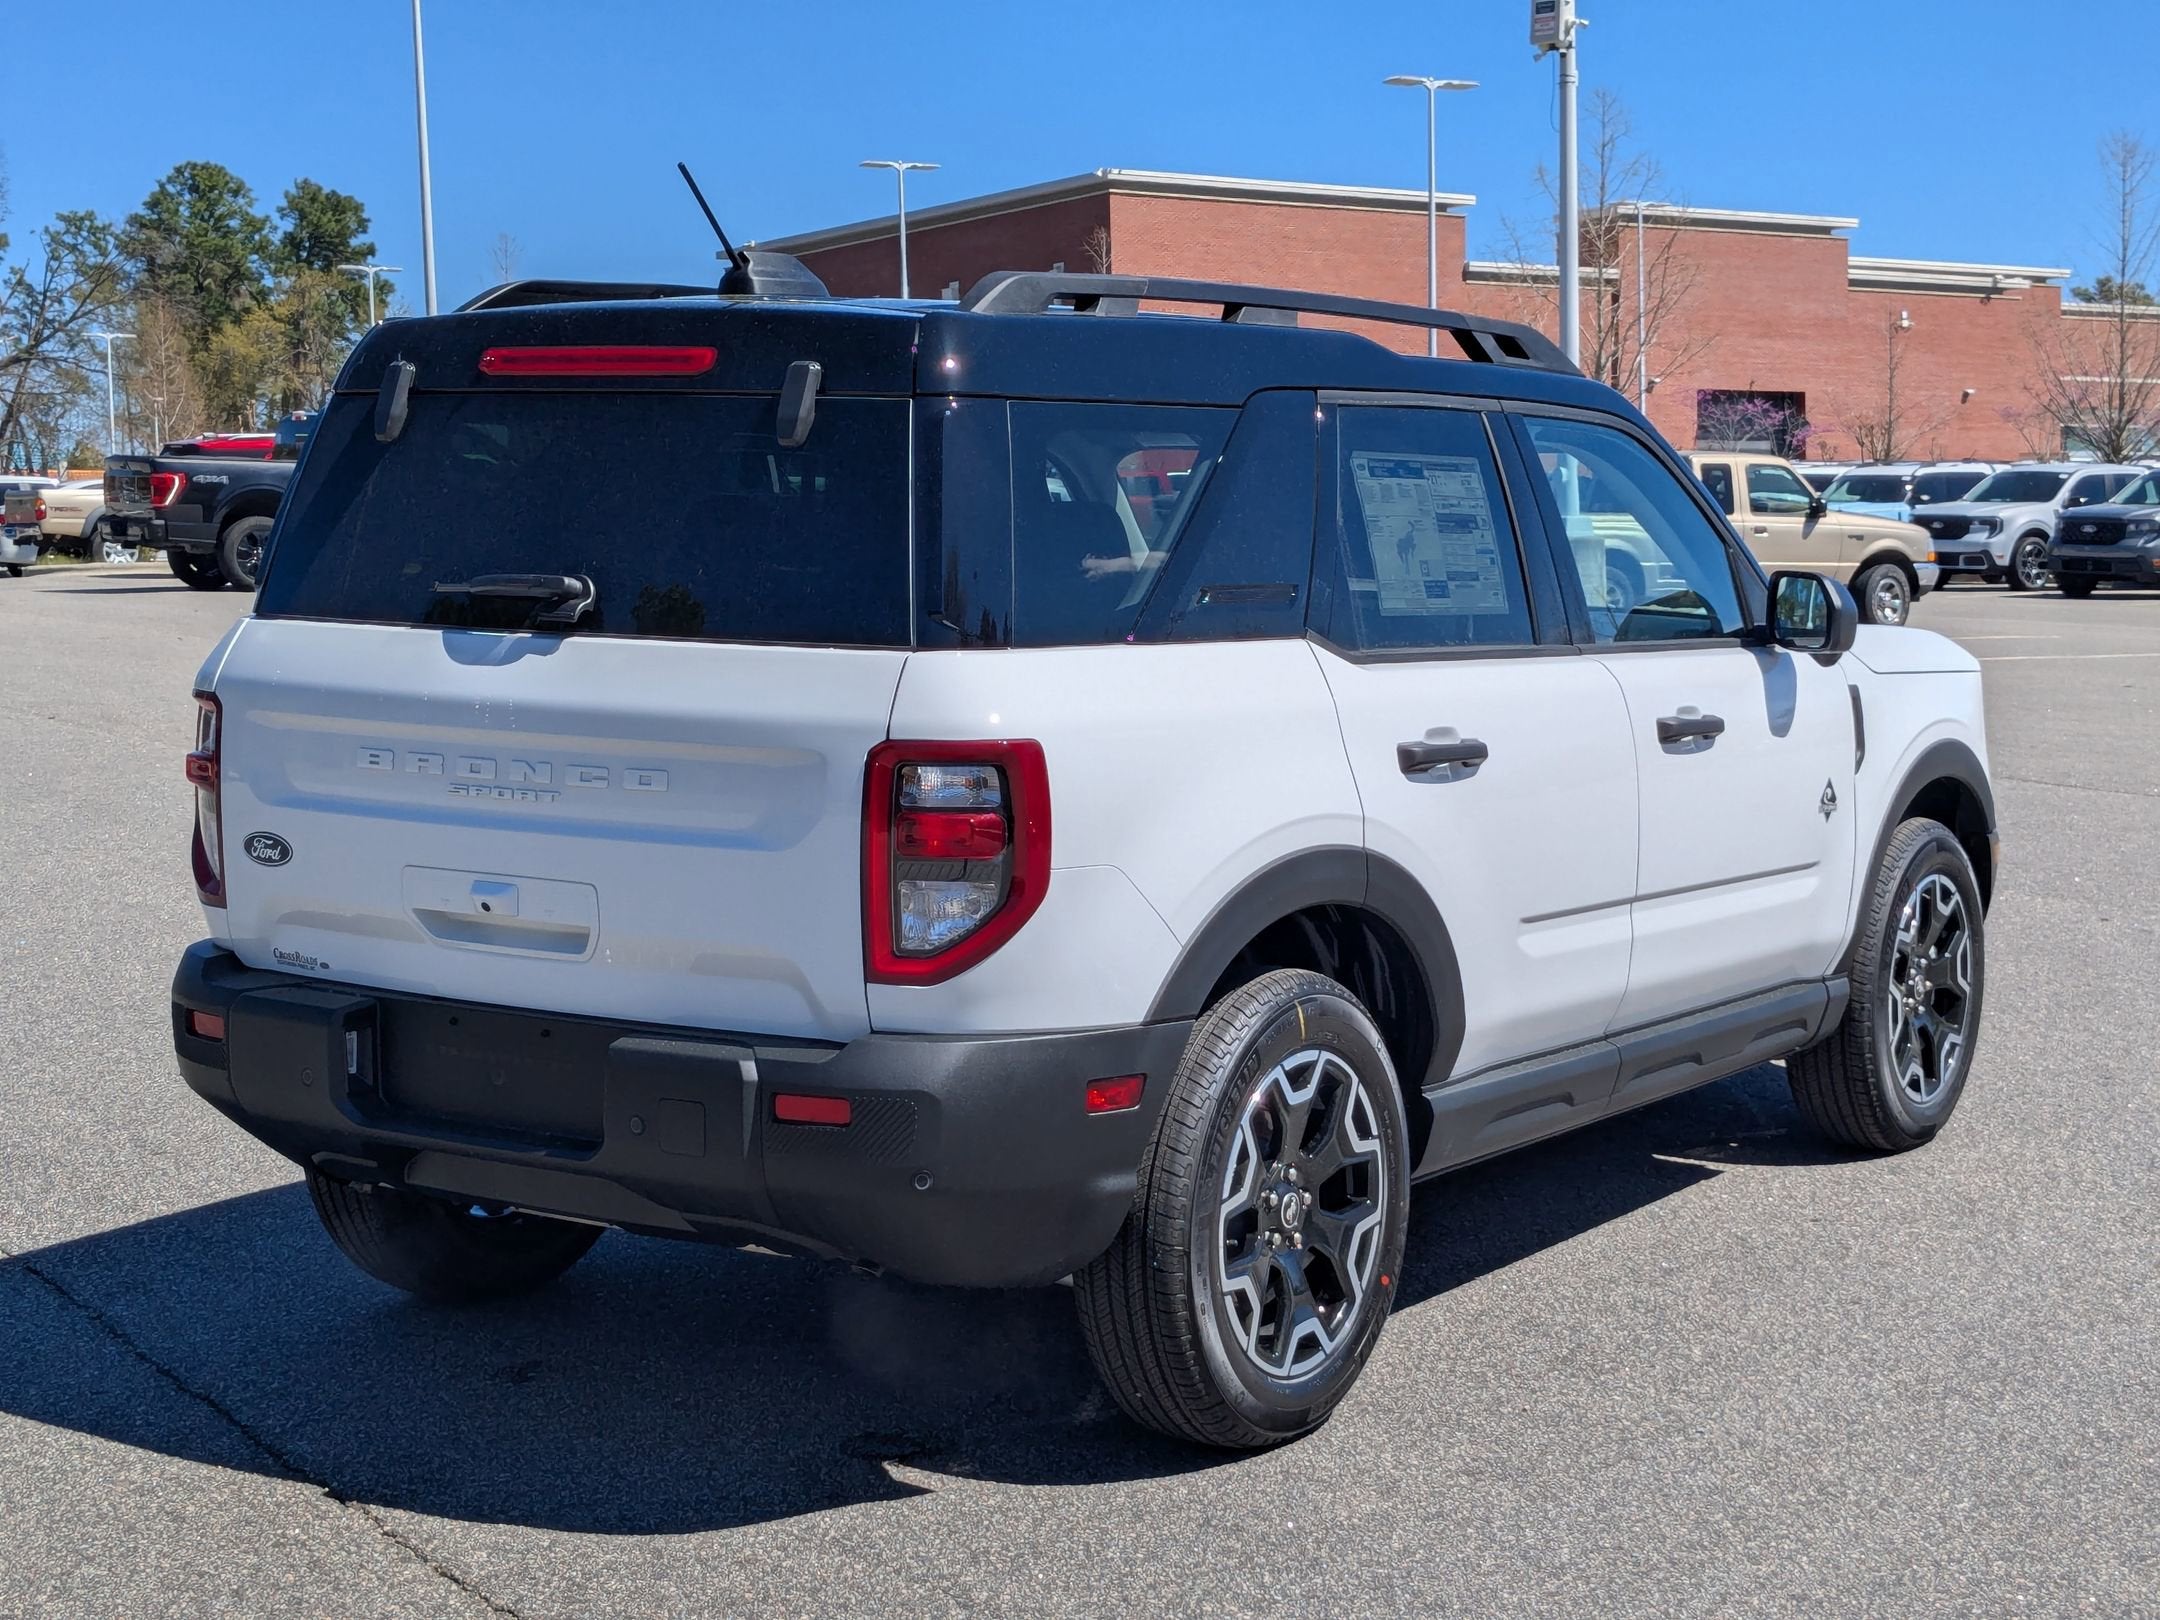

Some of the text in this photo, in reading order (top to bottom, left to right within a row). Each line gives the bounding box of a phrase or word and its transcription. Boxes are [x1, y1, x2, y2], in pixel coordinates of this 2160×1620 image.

[356, 746, 669, 792] BRONCO
[448, 783, 561, 802] SPORT
[251, 837, 282, 860] Ford
